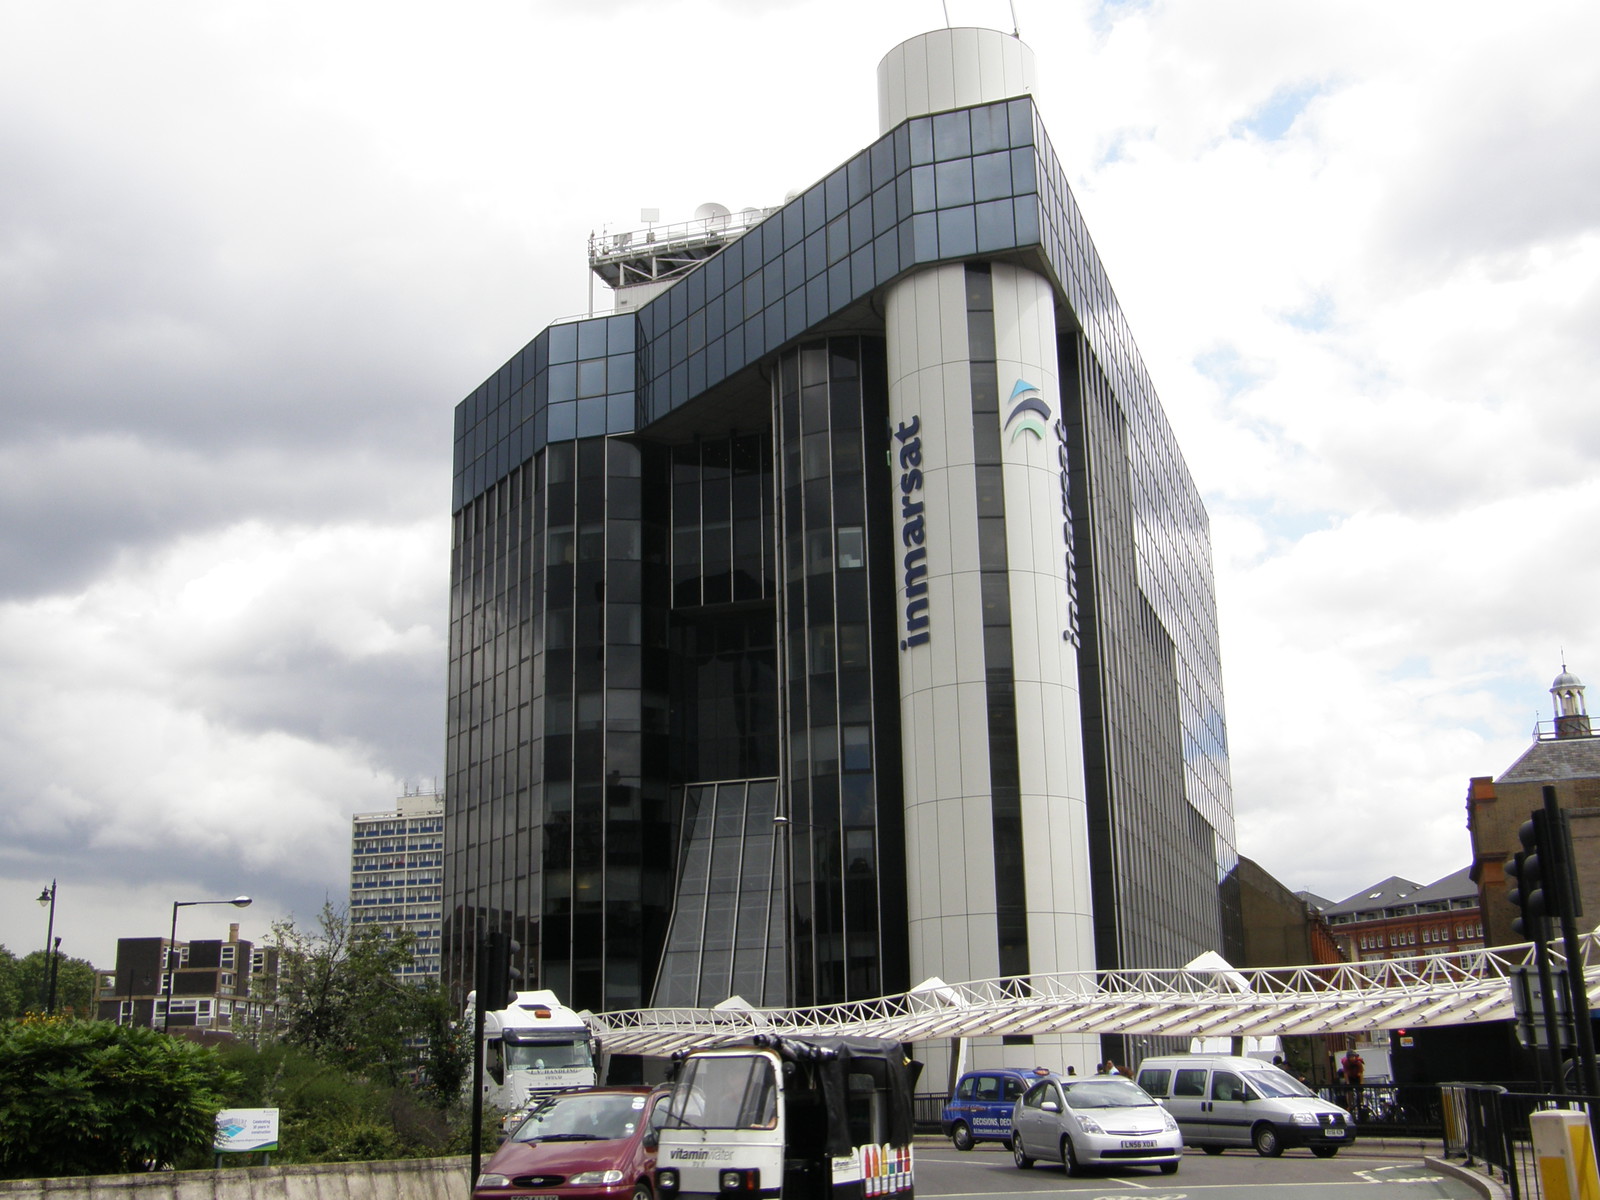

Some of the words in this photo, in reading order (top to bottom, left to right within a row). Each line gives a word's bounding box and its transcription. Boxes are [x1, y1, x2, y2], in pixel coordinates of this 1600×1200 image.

[894, 414, 930, 651] inmarsat
[1055, 418, 1081, 649] inmarsat
[670, 1147, 735, 1161] vitaminwater
